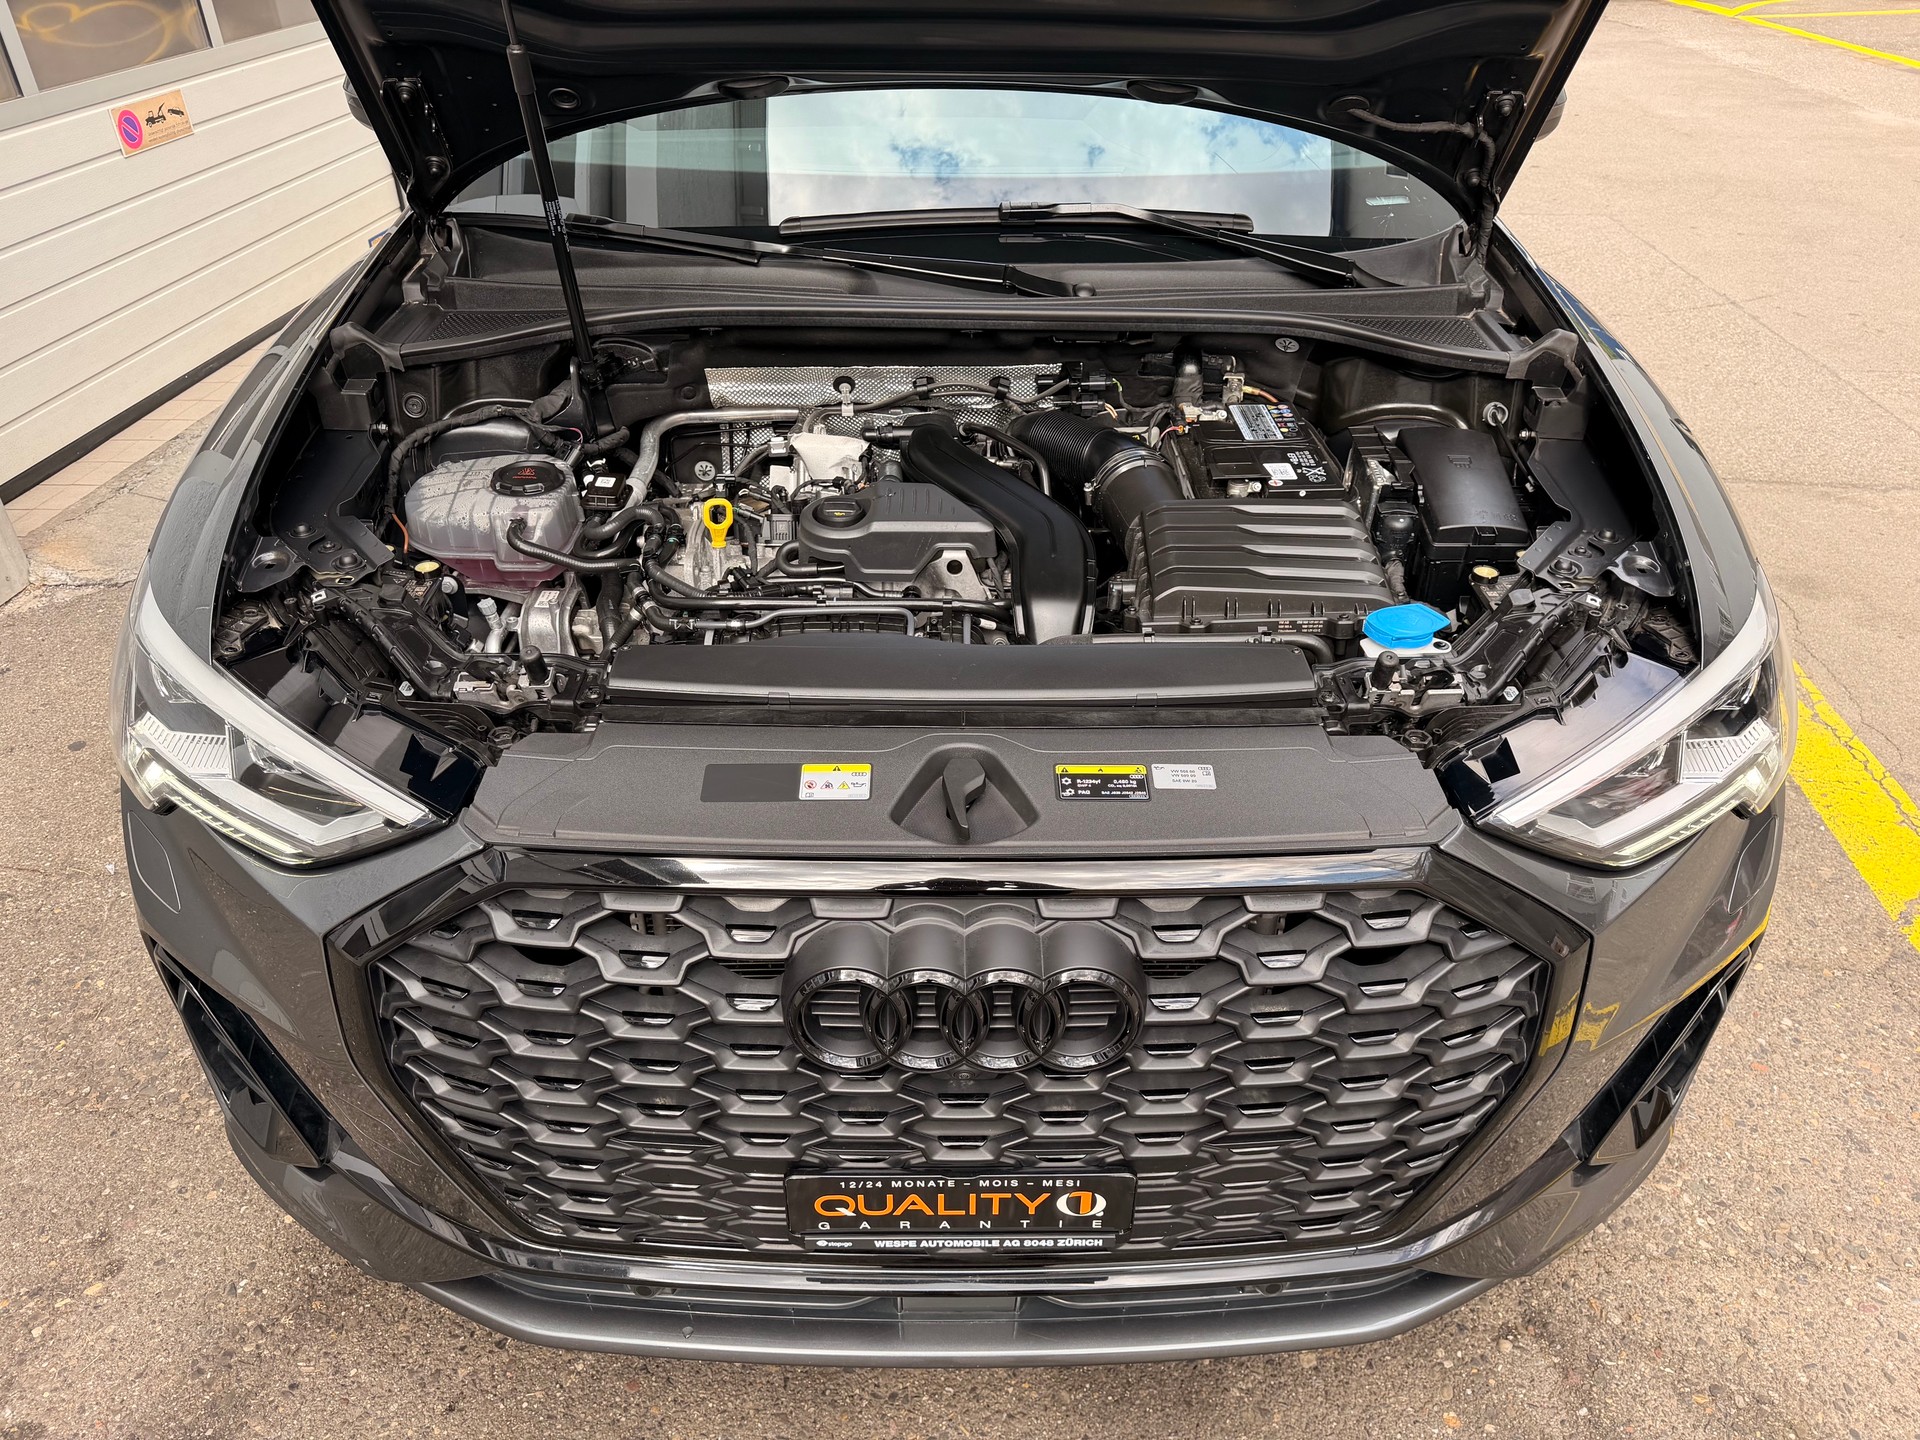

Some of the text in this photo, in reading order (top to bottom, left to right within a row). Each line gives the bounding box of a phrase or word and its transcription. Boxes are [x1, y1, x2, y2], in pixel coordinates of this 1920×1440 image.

[839, 1180, 883, 1189] 12/24
[891, 1179, 956, 1188] MONATE
[979, 1179, 1019, 1187] MOIS
[1042, 1179, 1081, 1187] MESI
[814, 1192, 1051, 1217] QUALITY
[818, 1219, 1103, 1230] GARANTIE
[874, 1239, 918, 1248] WESPE
[920, 1239, 1000, 1248] AUTOMOBILE
[1003, 1239, 1021, 1247] AG
[1023, 1239, 1054, 1247] 8048
[1057, 1237, 1103, 1247] ZÜRICH
